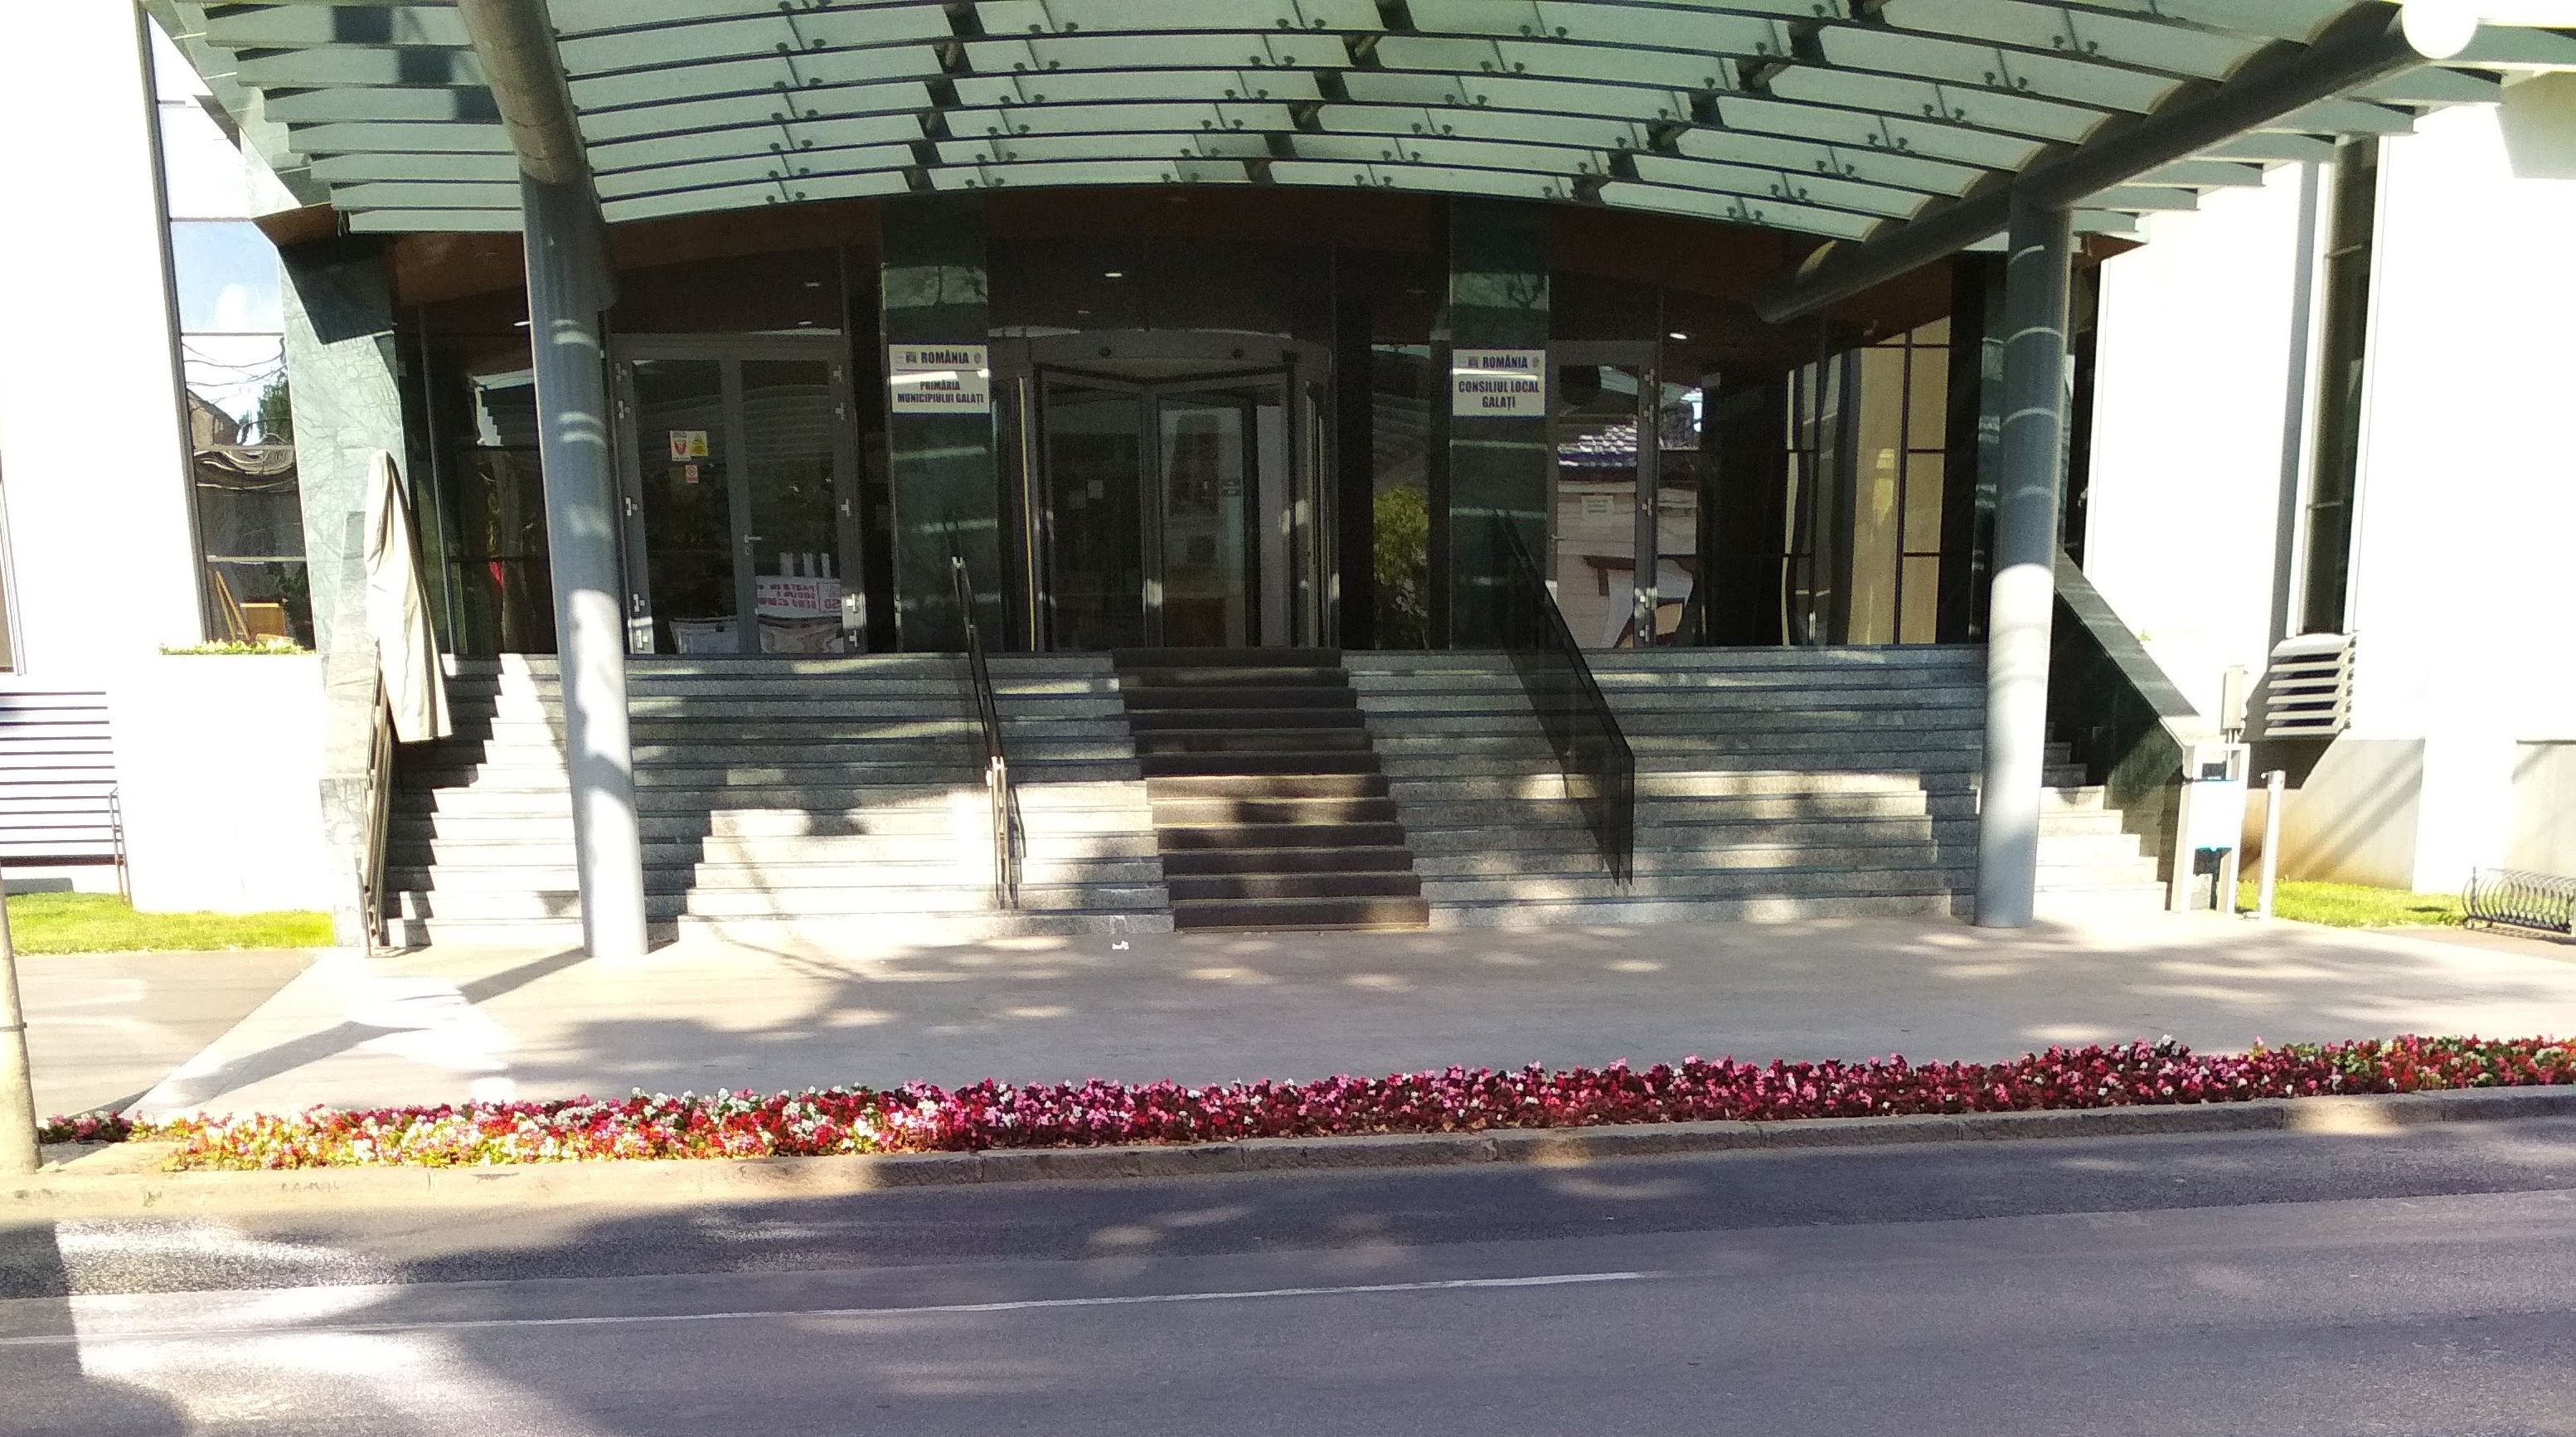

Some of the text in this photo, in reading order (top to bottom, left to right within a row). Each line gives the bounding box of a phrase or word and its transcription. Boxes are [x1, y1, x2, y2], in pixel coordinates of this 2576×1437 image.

[920, 349, 969, 364] ROMÂNIA
[1482, 354, 1528, 368] ROMÂNIA
[919, 379, 960, 391] PRIMĂRIA
[1458, 381, 1540, 393] CONSILIUL LOCAL
[897, 393, 953, 403] MUNICIPIULUI
